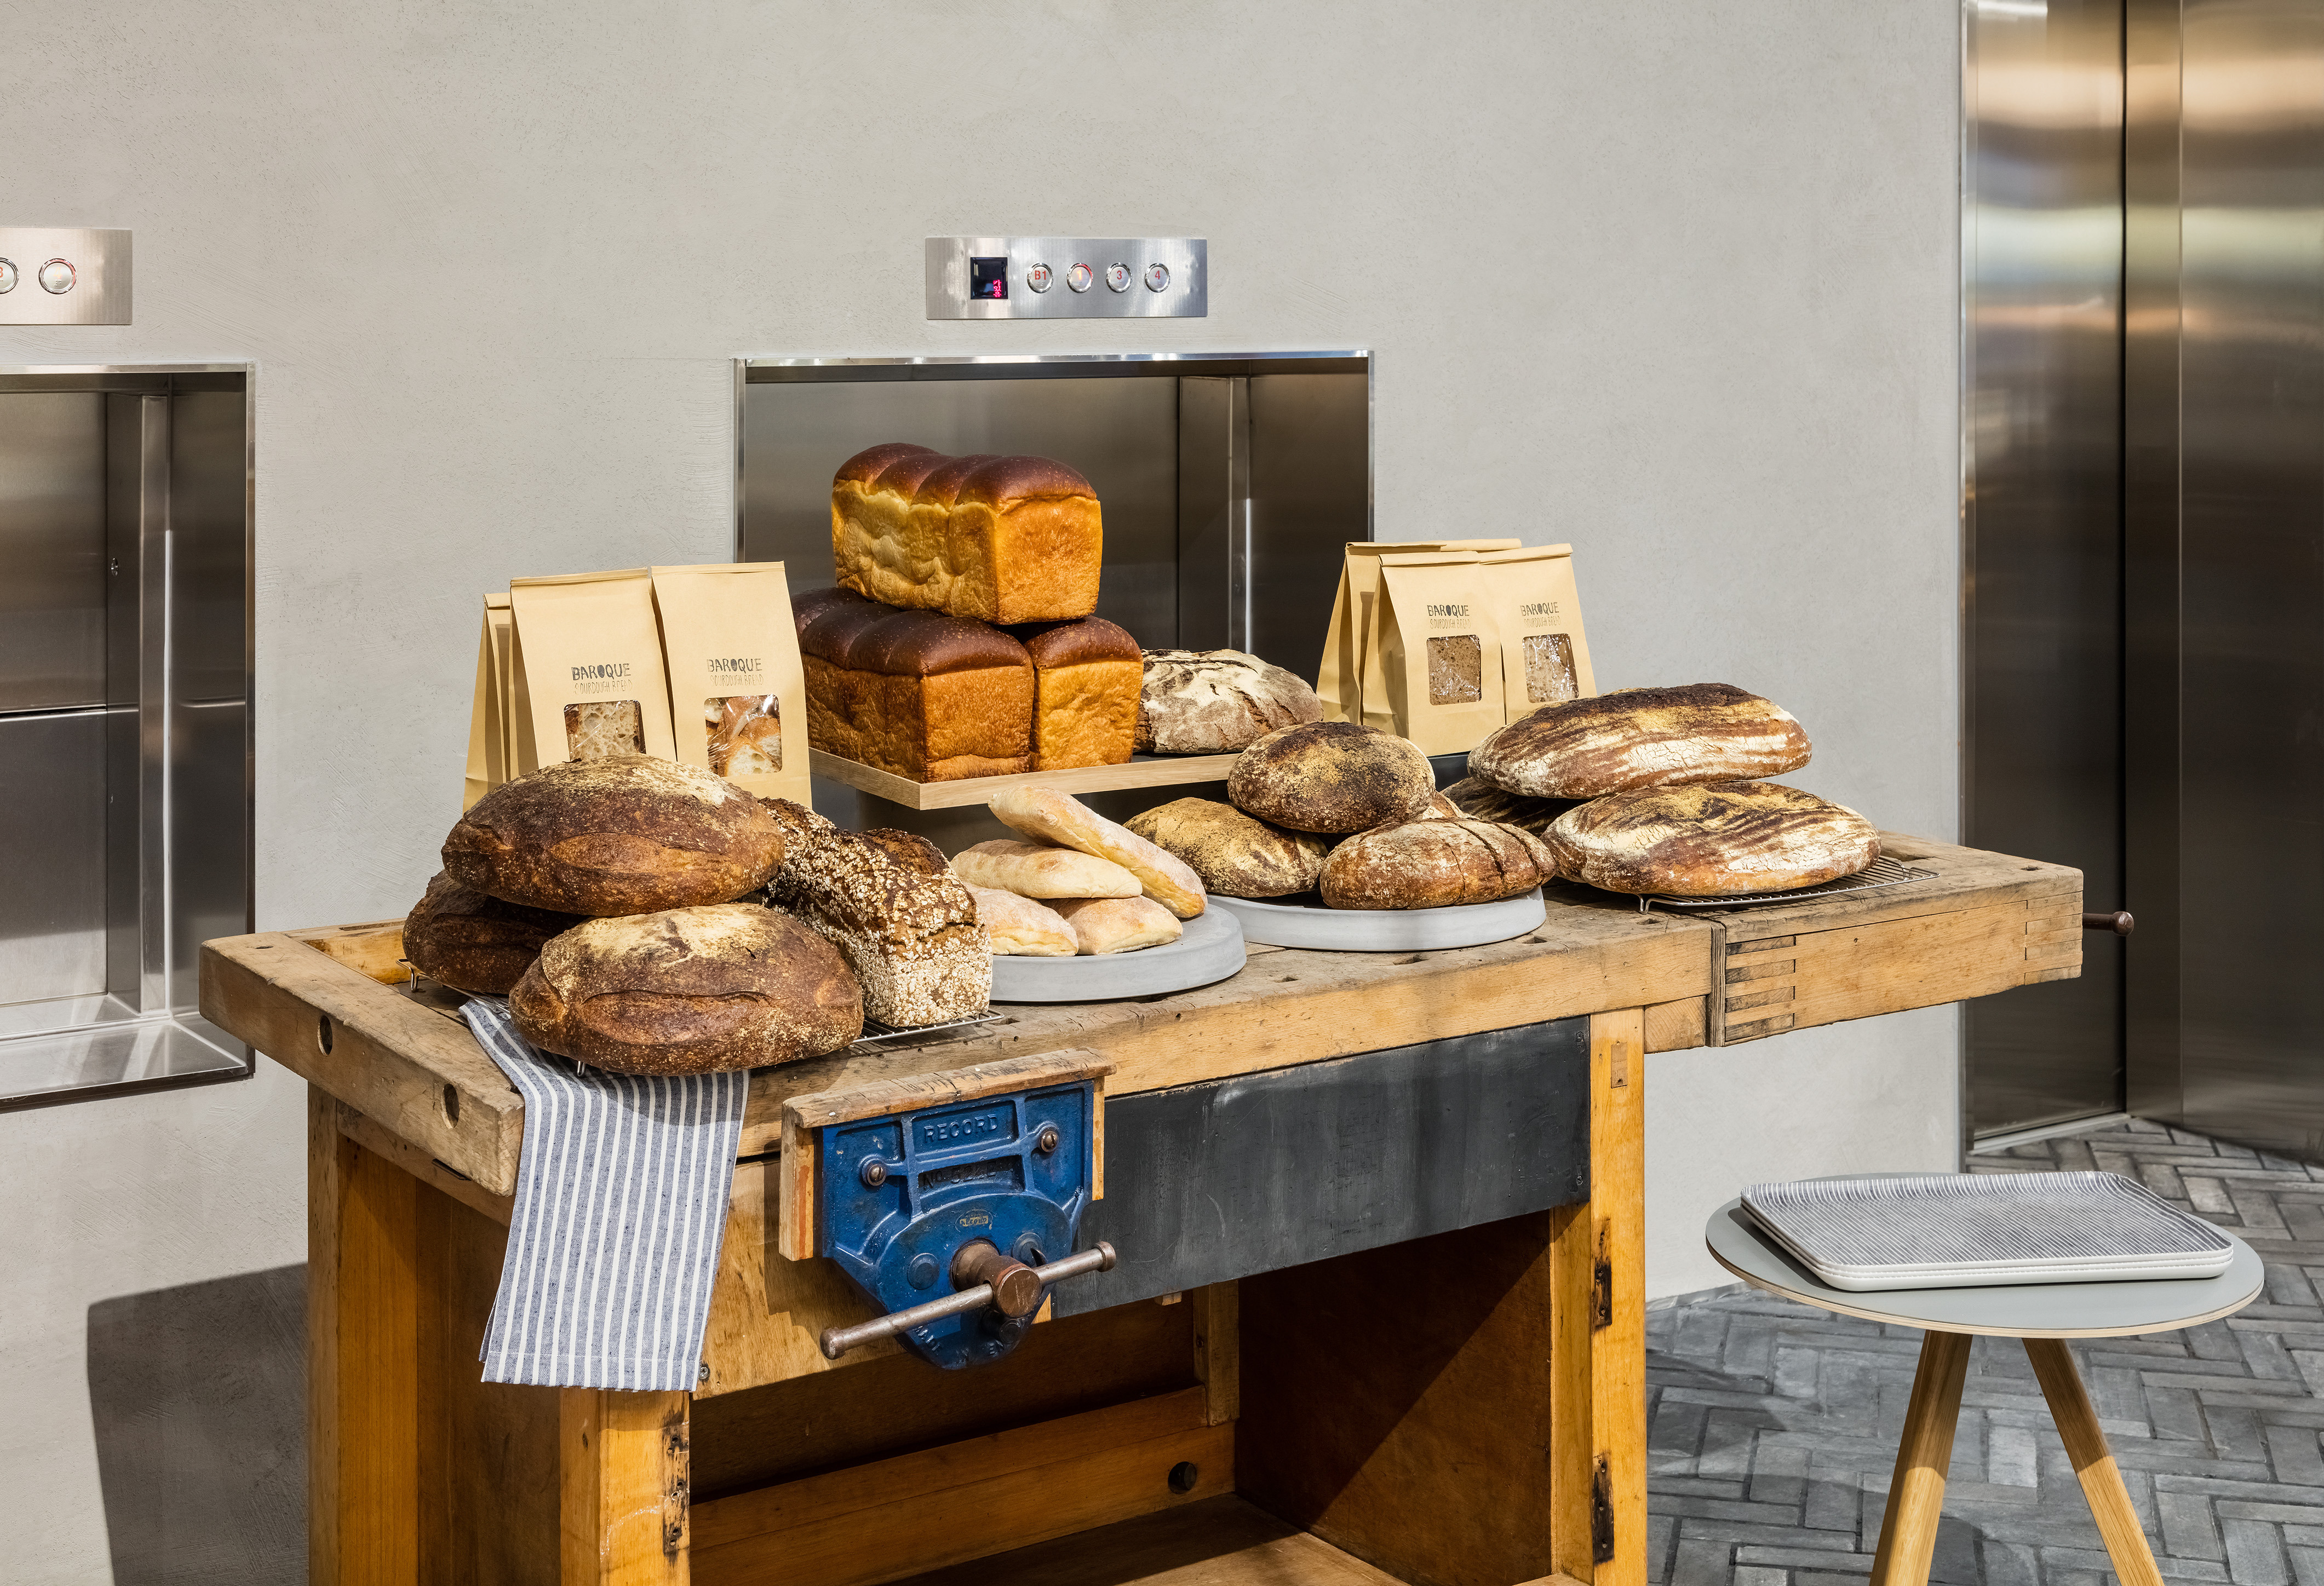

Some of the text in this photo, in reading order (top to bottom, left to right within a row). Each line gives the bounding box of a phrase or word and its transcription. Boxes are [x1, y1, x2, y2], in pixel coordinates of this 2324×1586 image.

[53, 267, 63, 279] 4
[1035, 270, 1046, 280] B1
[1077, 269, 1082, 280] 1
[1117, 270, 1122, 280] 3
[1155, 270, 1161, 280] 4
[1427, 605, 1470, 618] BAROQUE
[1519, 602, 1559, 617] BAROQUE
[1430, 619, 1471, 629] SOURDOUGH BREAD
[1524, 616, 1560, 628] SOURDOUGH BREAD
[571, 663, 631, 680] BAROQUE
[707, 658, 762, 674] BAROQUE
[710, 675, 742, 686] SOURDOUGH
[573, 681, 610, 694] SOURDOUGH
[924, 1114, 998, 1143] RECORD
